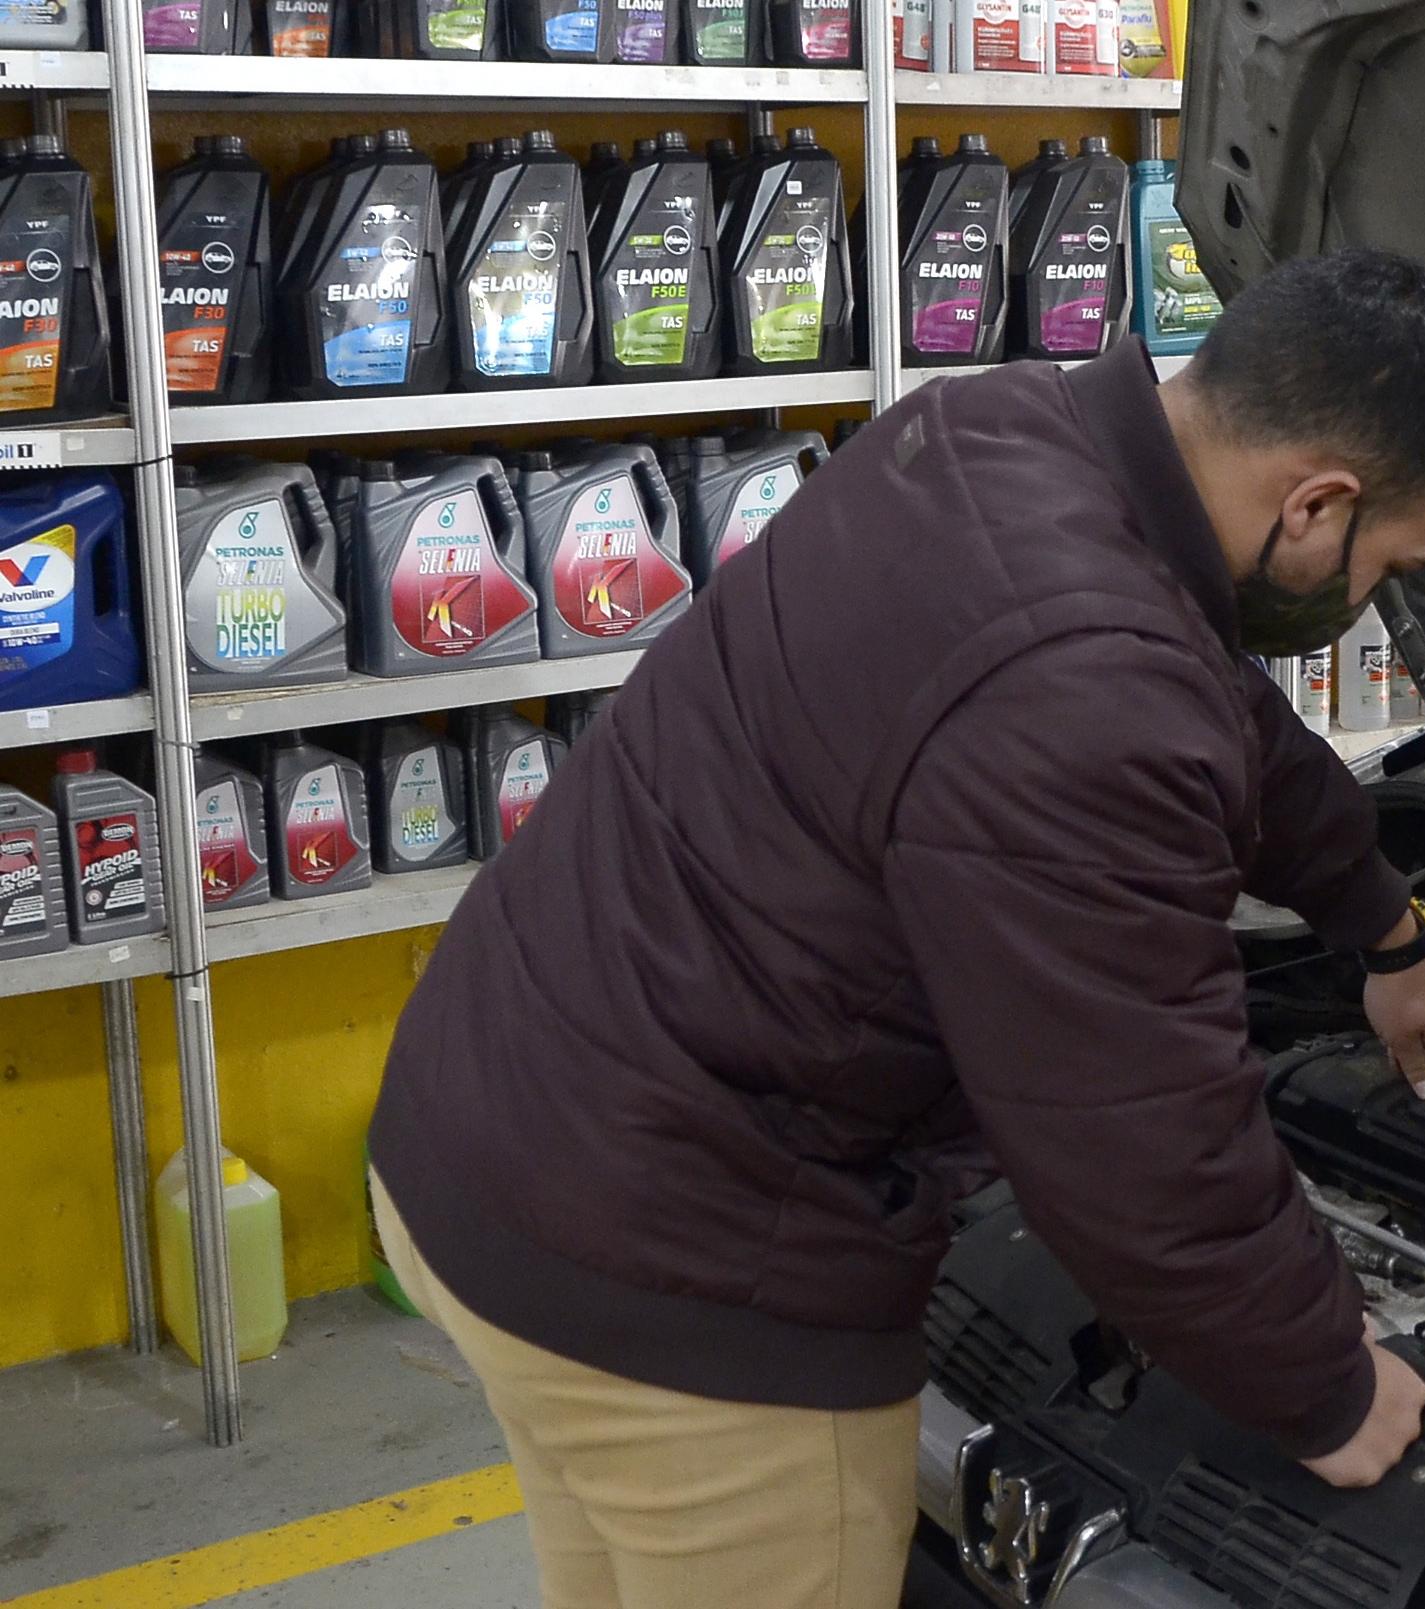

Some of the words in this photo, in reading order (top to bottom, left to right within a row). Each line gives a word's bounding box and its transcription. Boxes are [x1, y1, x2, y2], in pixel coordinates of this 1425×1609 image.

[275, 1, 328, 13] ELAION
[617, 0, 664, 11] ELAION
[697, 0, 745, 9] ELAION
[803, 0, 849, 9] ELAION
[179, 10, 198, 20] TAS
[466, 15, 481, 25] TAS
[1121, 14, 1152, 25] Paraflu
[579, 17, 595, 27] TAS
[649, 28, 662, 38] TAS
[729, 25, 743, 35] TAS
[26, 220, 49, 229] YPF
[205, 215, 227, 223] YPF
[617, 268, 689, 286] ELAION
[919, 262, 983, 279] ELAION
[1045, 264, 1107, 280] ELAION
[479, 275, 553, 292] ELAION
[958, 280, 980, 291] F10
[1083, 280, 1104, 291] F10
[327, 282, 410, 302] ELAION
[523, 292, 552, 306] F50
[194, 306, 226, 320] F30
[378, 300, 408, 315] F50
[1081, 307, 1101, 320] TAS
[796, 313, 817, 325] TAS
[955, 308, 976, 321] TAS
[23, 319, 57, 333] F30
[661, 316, 684, 328] TAS
[192, 339, 219, 353] TAS
[379, 333, 404, 347] TAS
[25, 353, 53, 369] TAS
[575, 519, 635, 532] PETRONAS
[416, 534, 480, 547] PETRONAS
[578, 532, 637, 559] SELENIA
[216, 546, 284, 558] PETRONAS
[419, 548, 481, 574] SELENIA
[218, 560, 286, 586] SELENIA
[216, 588, 287, 625] TURBO
[216, 622, 286, 658] DIESEL
[402, 823, 440, 847] DIESEL
[84, 849, 139, 878] HYPOID
